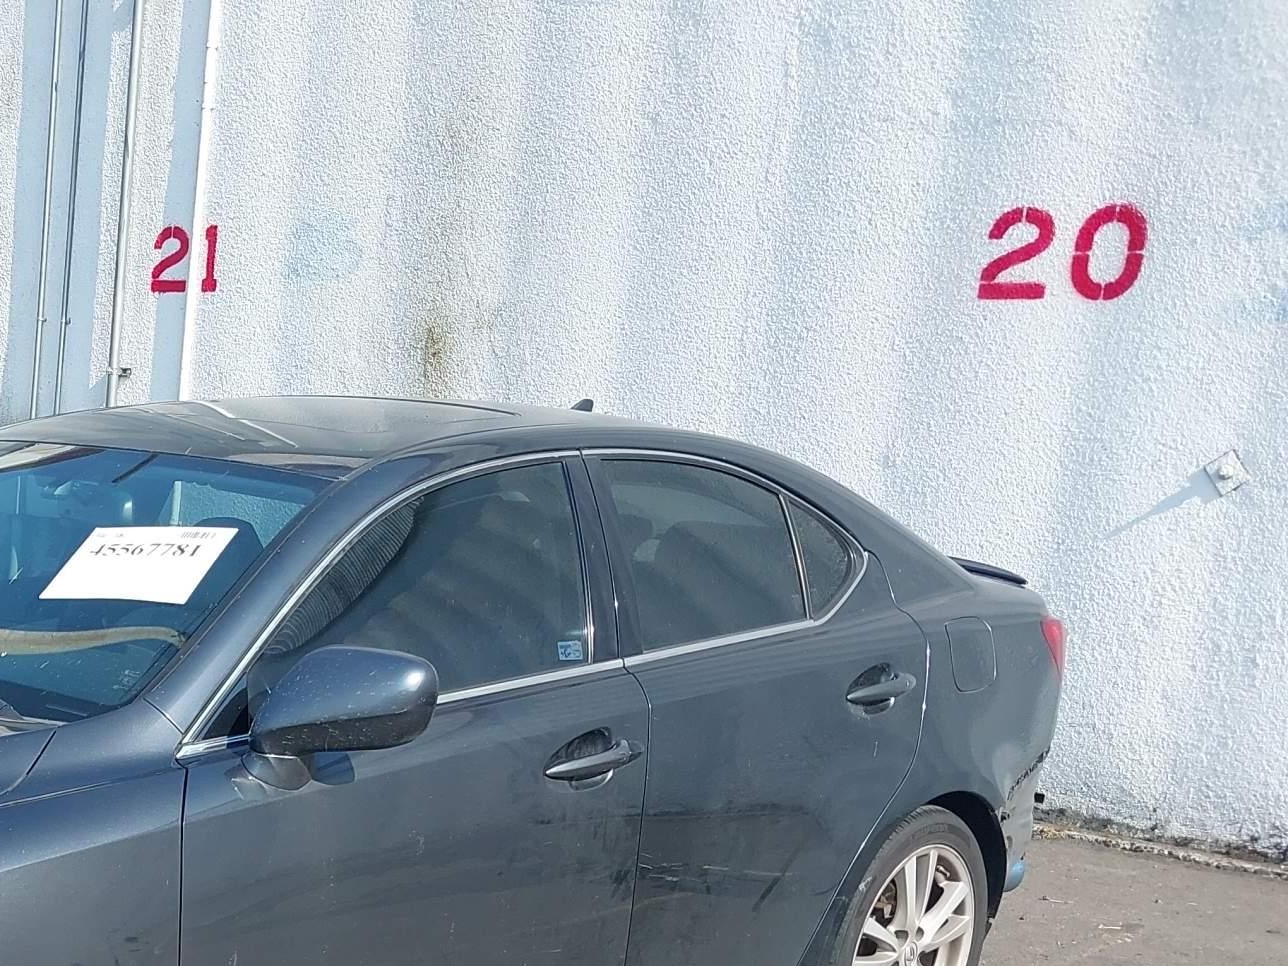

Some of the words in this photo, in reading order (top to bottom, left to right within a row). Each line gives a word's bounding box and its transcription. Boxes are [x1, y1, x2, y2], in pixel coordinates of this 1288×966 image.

[150, 224, 218, 293] 21
[978, 203, 1148, 301] 20
[90, 543, 201, 557] 45567781
